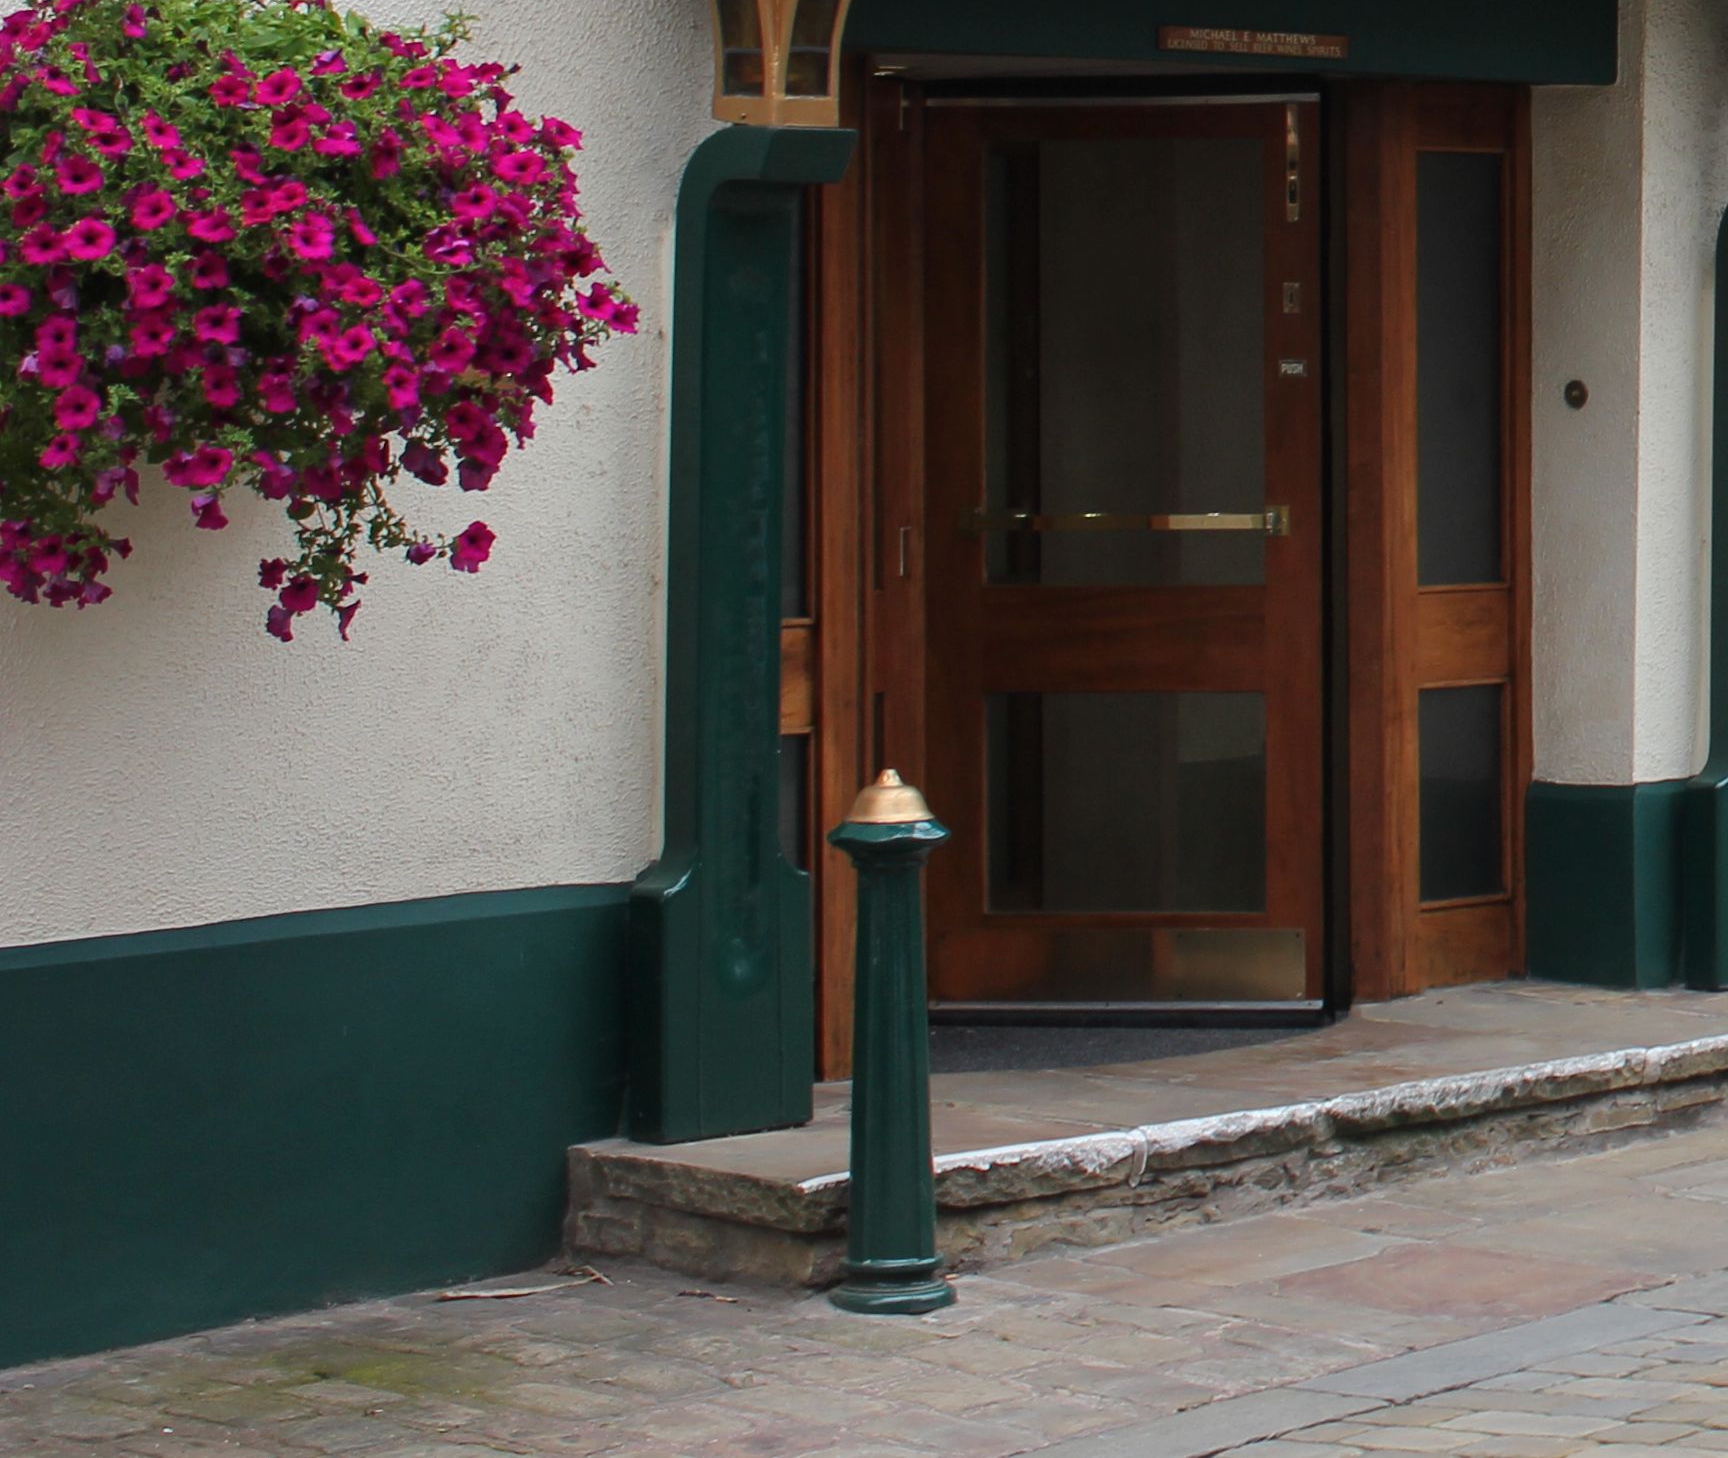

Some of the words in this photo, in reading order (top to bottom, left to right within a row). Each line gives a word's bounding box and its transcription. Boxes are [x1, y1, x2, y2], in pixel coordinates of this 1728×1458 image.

[1188, 28, 1238, 42] MICHAEL
[1256, 32, 1317, 45] MATTHEWS
[1212, 40, 1225, 51] TO
[1281, 362, 1304, 374] PUSH
